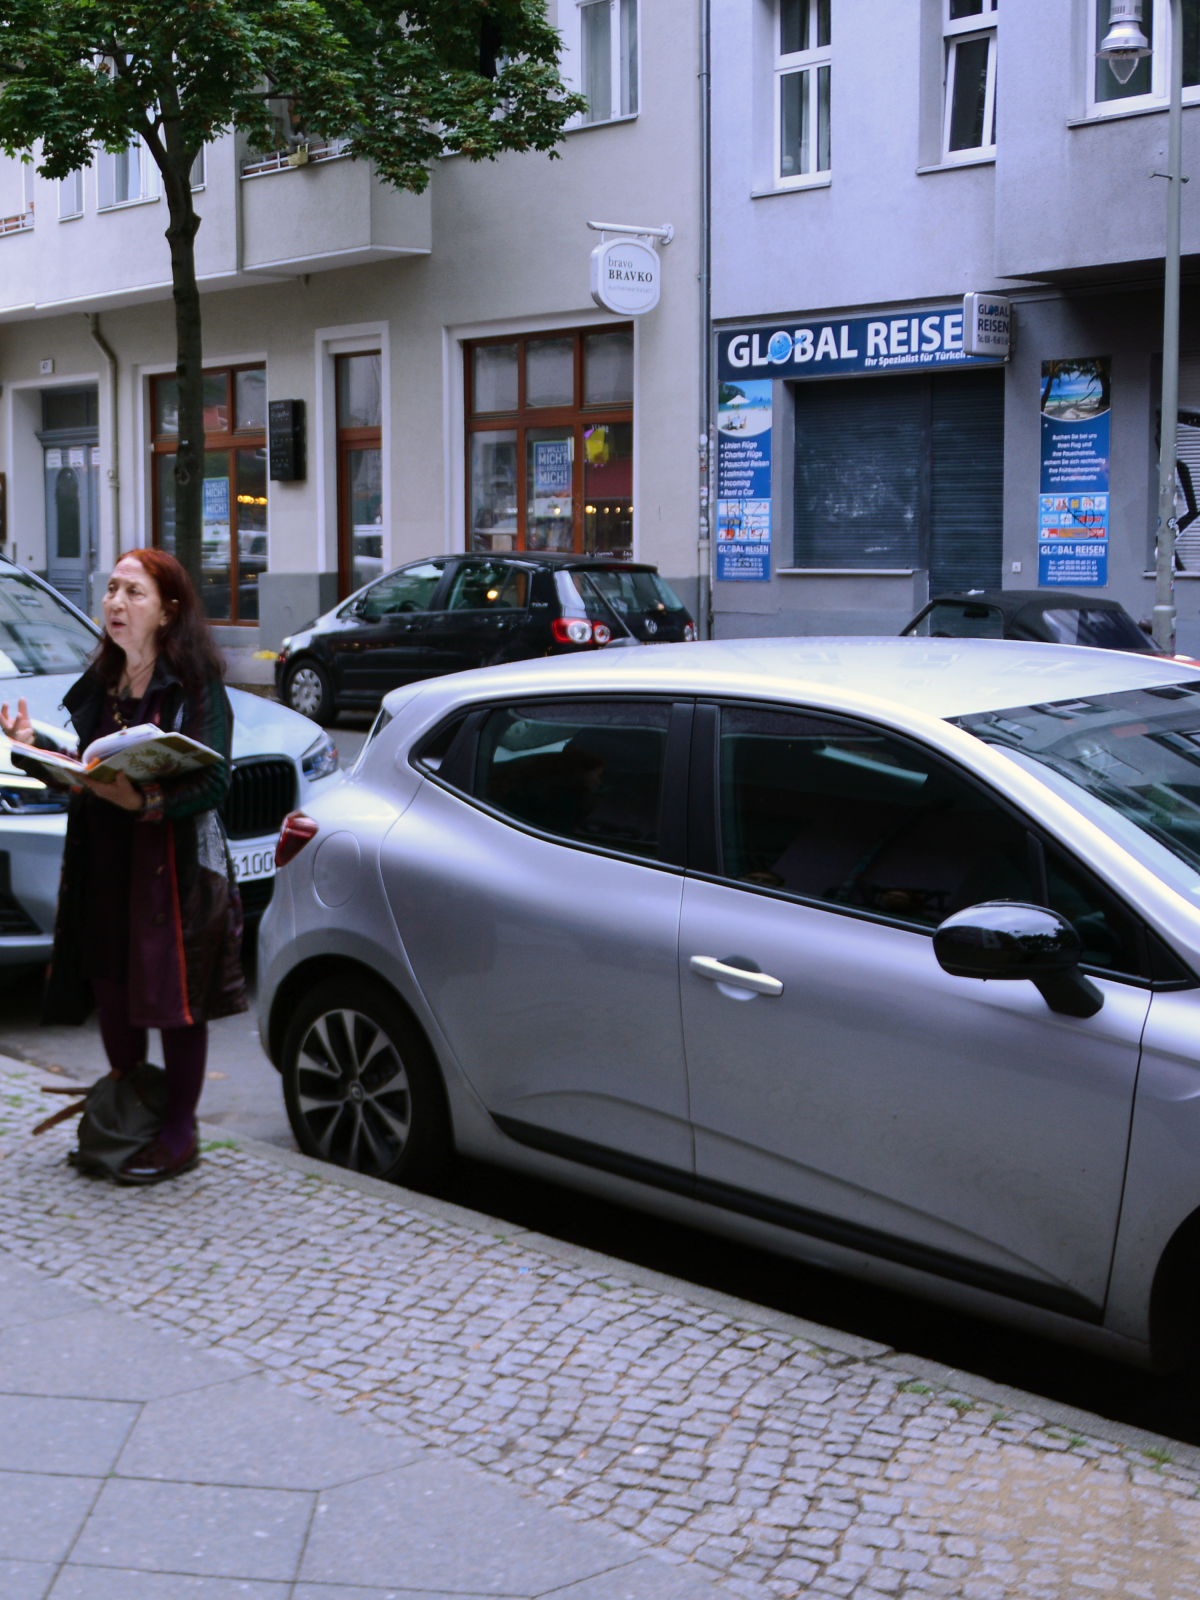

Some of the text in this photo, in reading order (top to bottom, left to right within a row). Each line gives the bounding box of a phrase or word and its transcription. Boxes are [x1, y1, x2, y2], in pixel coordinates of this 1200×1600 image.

[608, 256, 633, 268] bravo
[608, 269, 653, 283] BRAVKO
[978, 304, 1009, 318] GLOBAL
[978, 319, 1009, 333] REISEN
[727, 314, 963, 368] GLOBAL REISE
[864, 357, 878, 367] Ihr
[879, 354, 919, 367] Spezialist
[920, 353, 934, 362] für
[538, 453, 568, 465] MICH?
[724, 451, 747, 459] Charter
[724, 460, 750, 468] Pauschal
[539, 471, 568, 483] MICH!
[724, 470, 755, 478] Lastminute
[724, 479, 751, 487] Incoming
[205, 488, 227, 498] MICH?
[743, 488, 755, 496] Car
[206, 503, 227, 513] MICH!
[718, 544, 769, 553] GLOBAL REISEN
[1040, 545, 1106, 555] GLOBAL REISEN
